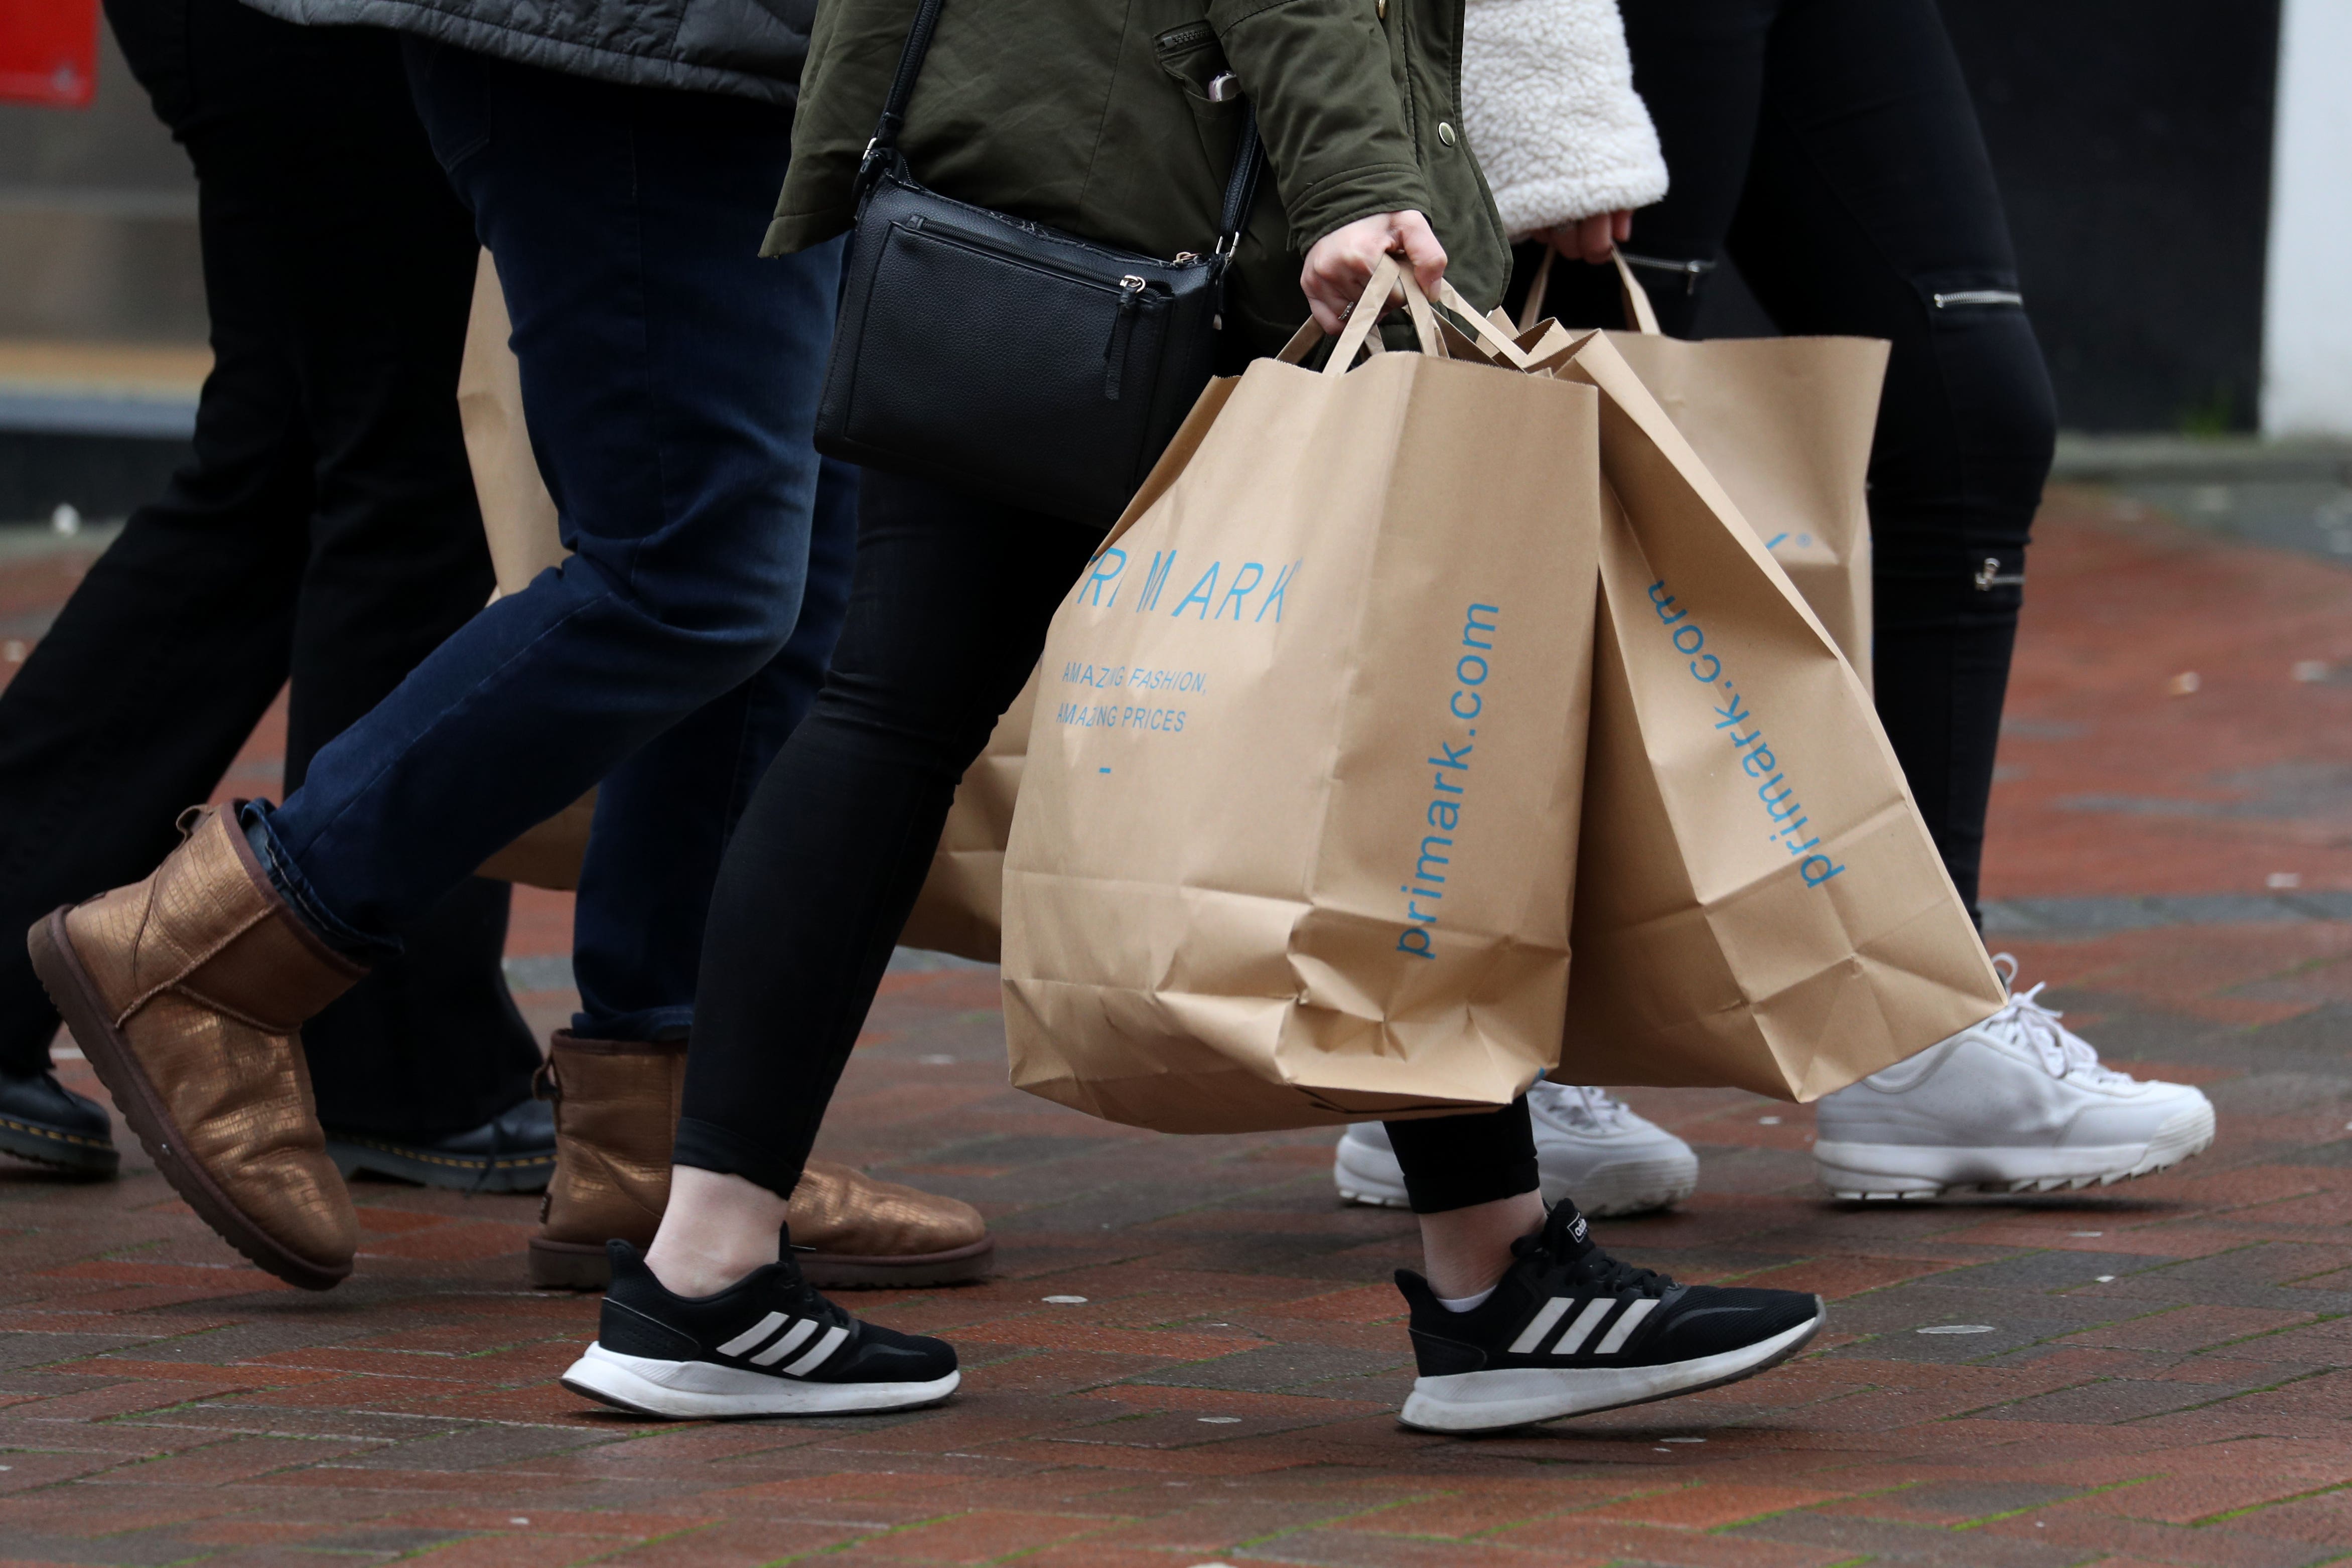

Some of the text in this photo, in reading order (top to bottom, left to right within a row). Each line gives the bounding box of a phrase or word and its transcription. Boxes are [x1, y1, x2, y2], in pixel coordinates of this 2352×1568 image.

[1056, 703, 1187, 733] AMAZING PRICES
[1127, 667, 1207, 695] FASHION,
[1648, 581, 1846, 888] primark.com
[1397, 603, 1499, 959] primark.com
